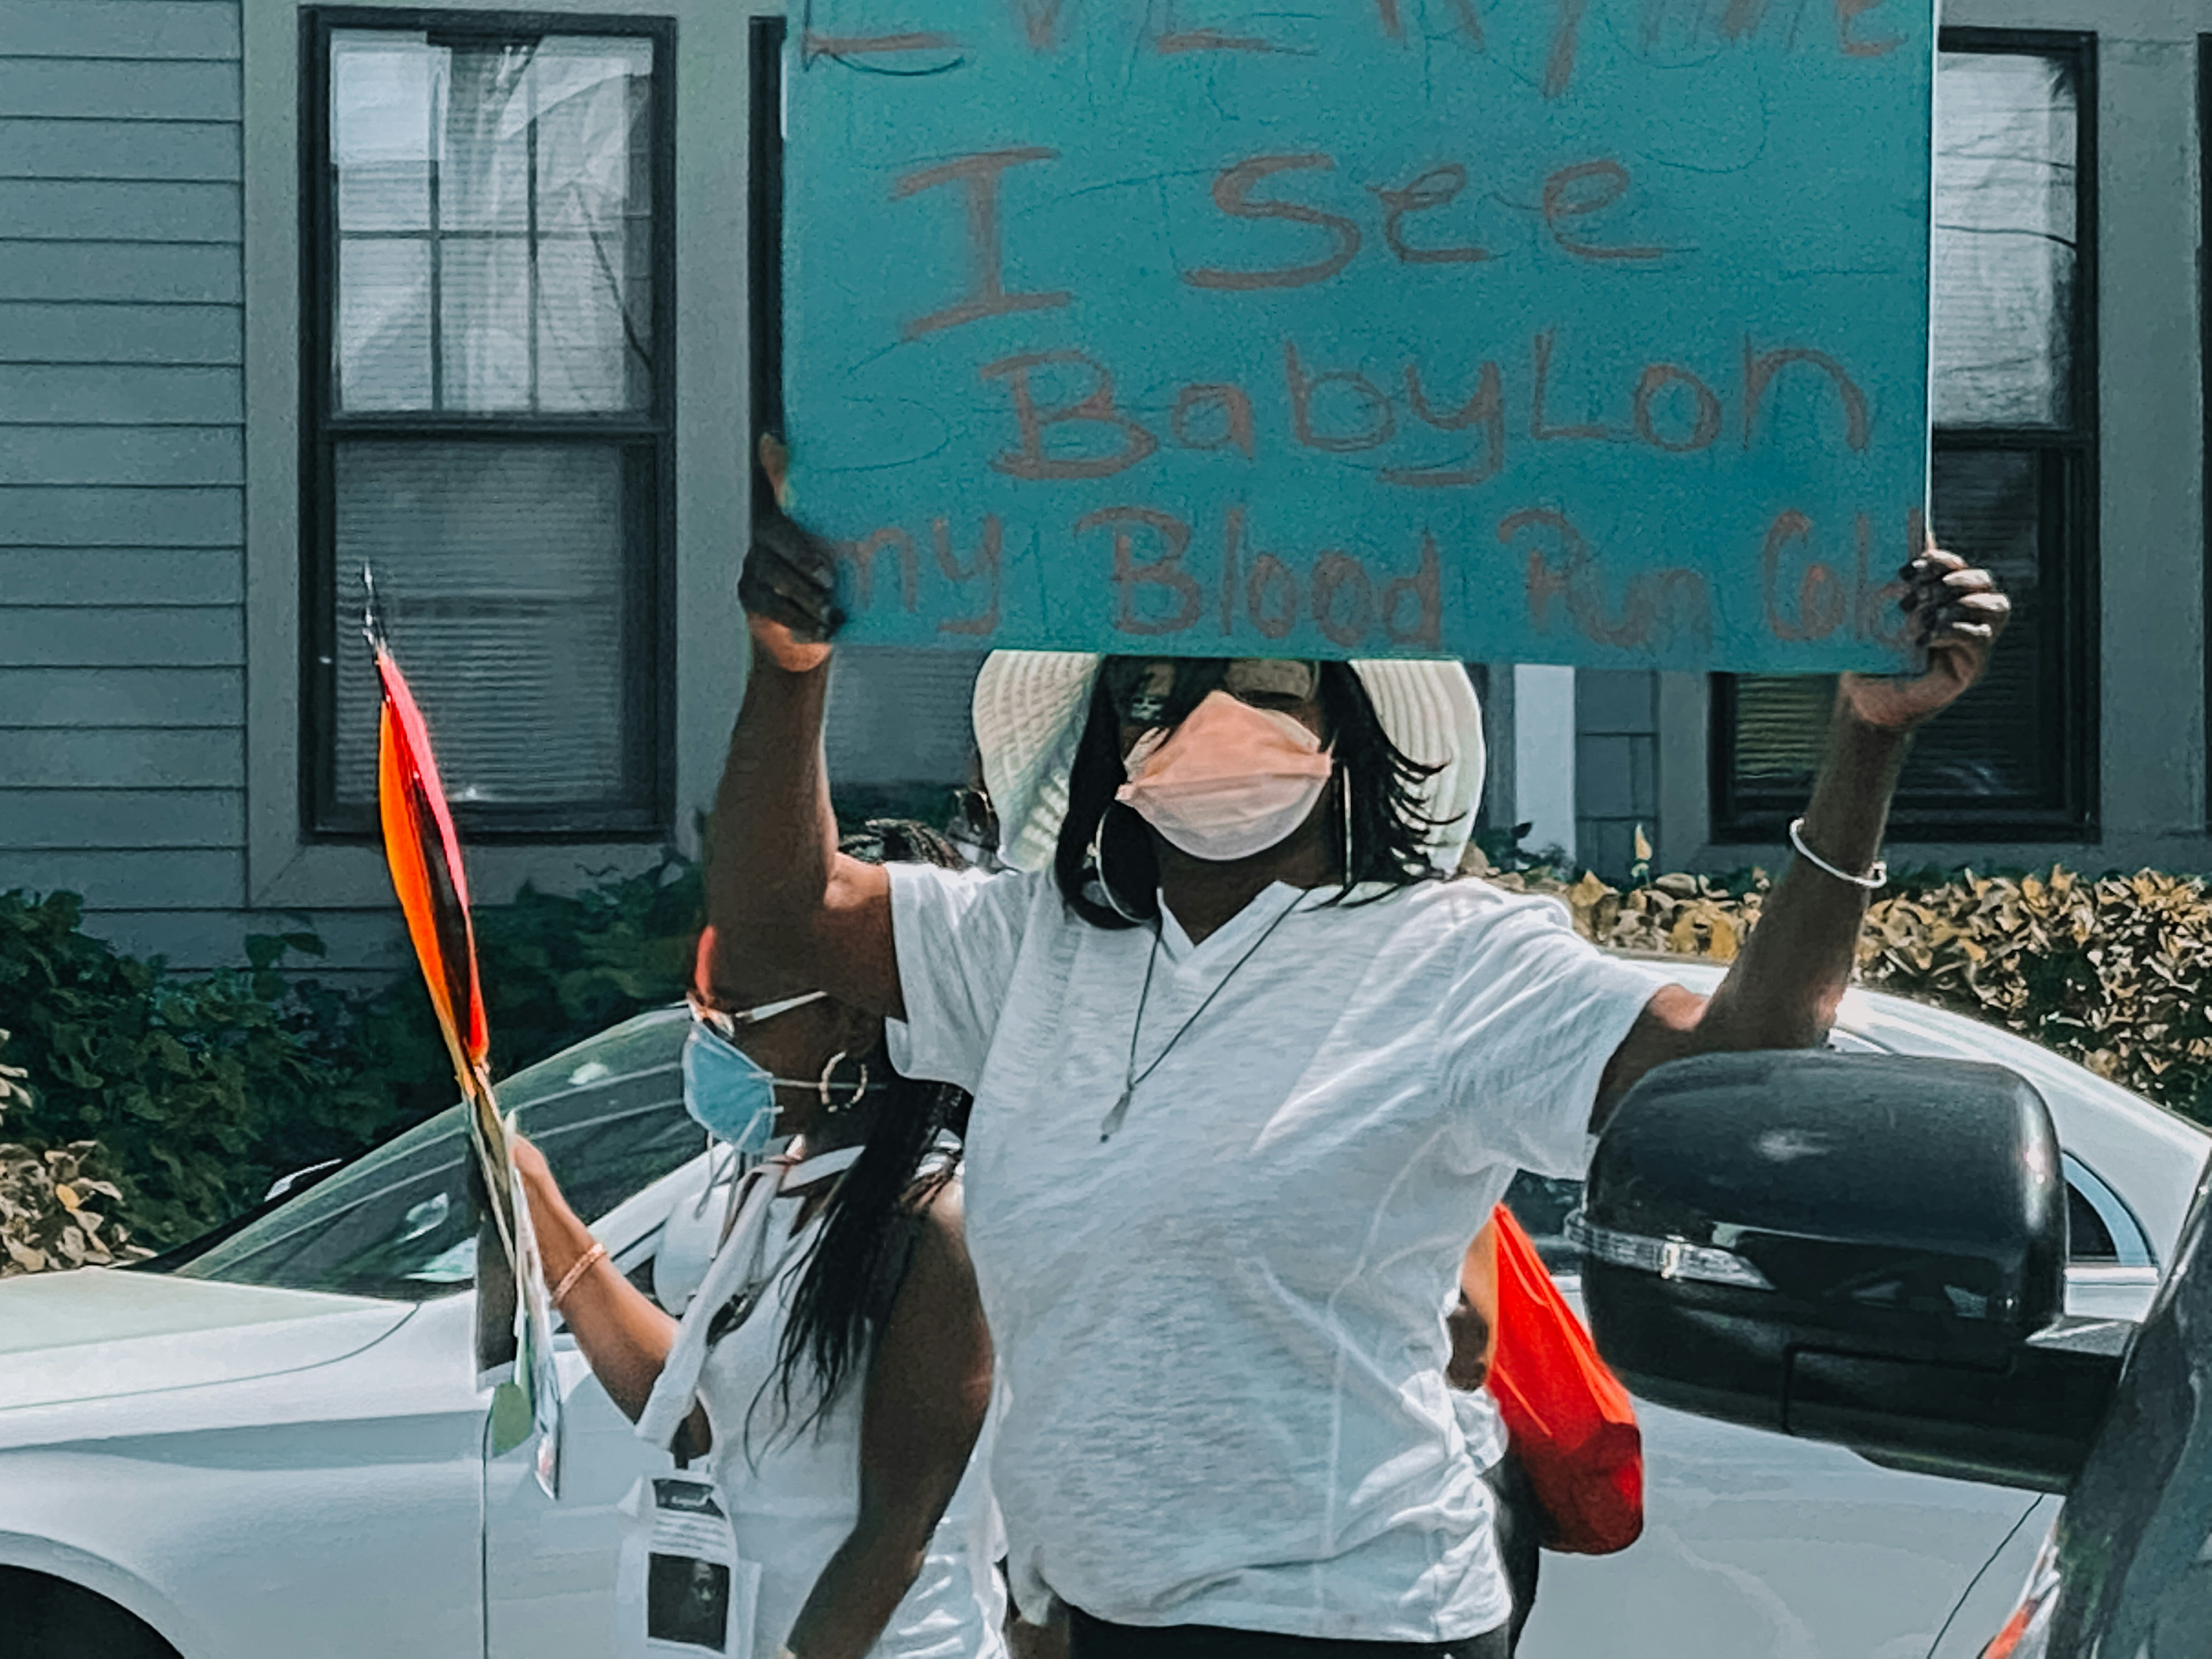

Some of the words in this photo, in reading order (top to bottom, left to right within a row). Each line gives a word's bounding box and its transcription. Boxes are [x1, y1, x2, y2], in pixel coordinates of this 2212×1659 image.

[888, 145, 1073, 341] I
[1182, 149, 1692, 291] See
[1073, 505, 1443, 652] Blood
